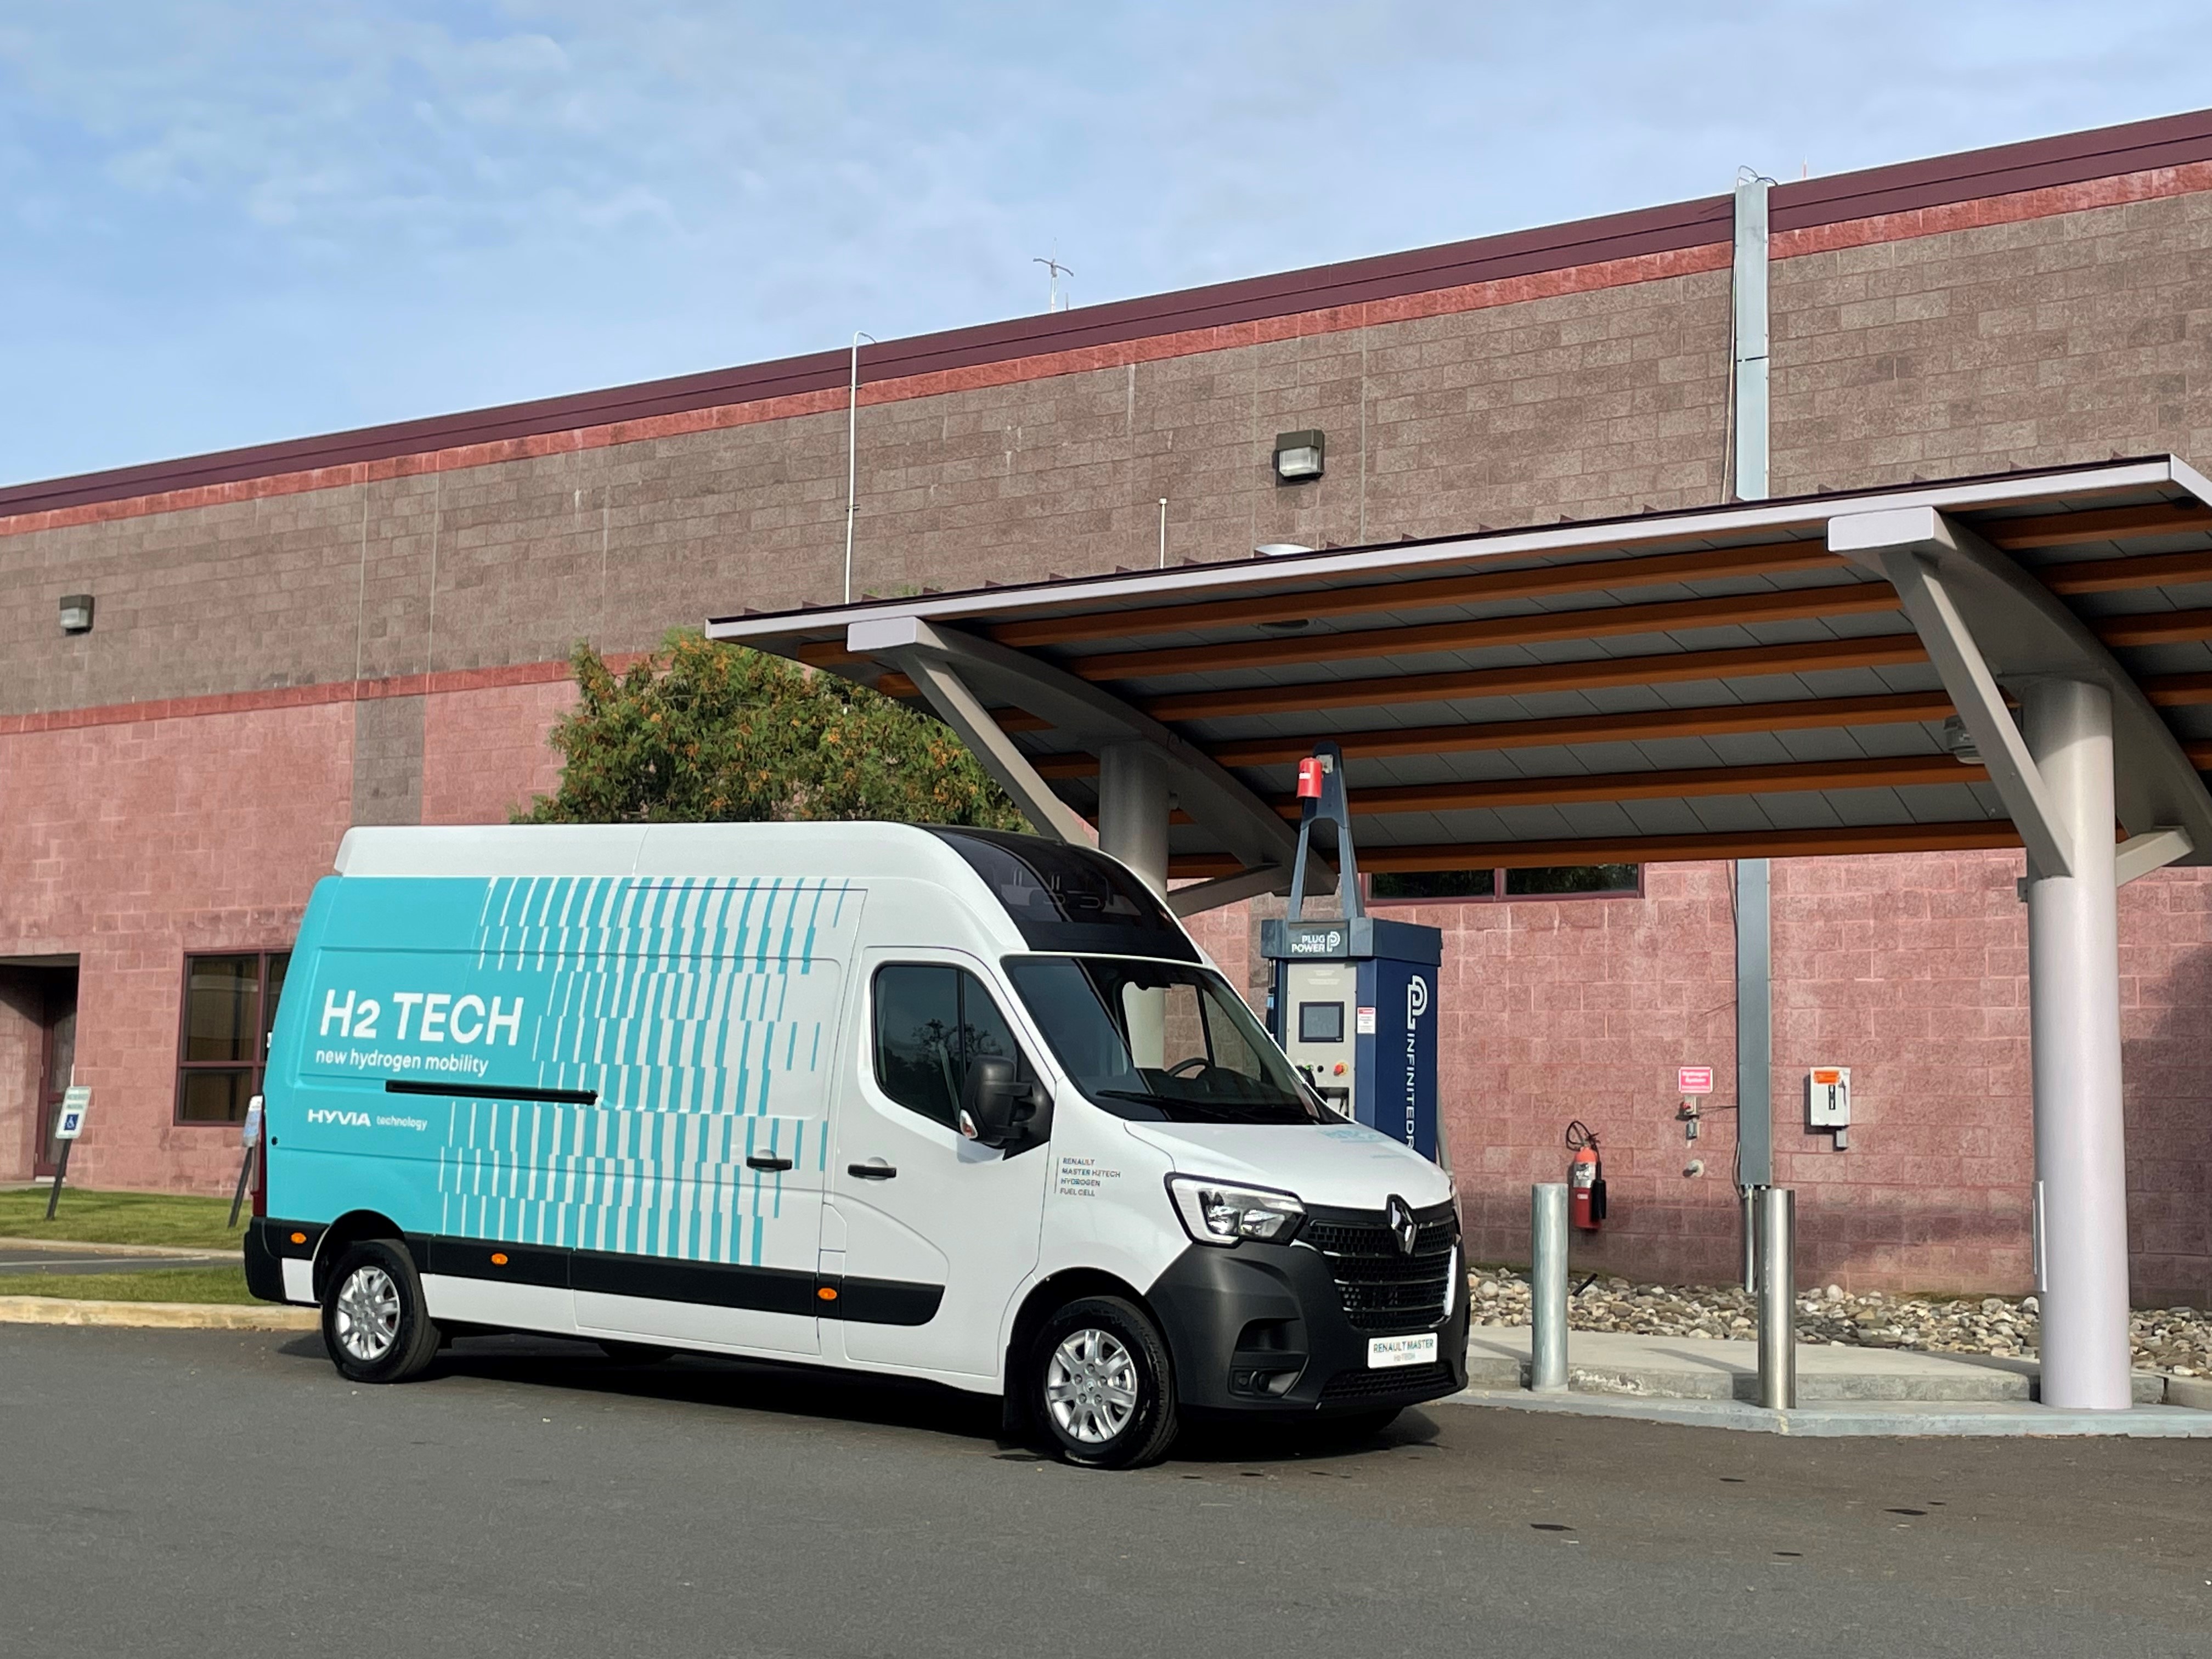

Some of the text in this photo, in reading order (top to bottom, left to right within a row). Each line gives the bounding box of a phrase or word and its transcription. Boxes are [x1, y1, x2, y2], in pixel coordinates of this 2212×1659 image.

[1301, 935, 1325, 943] PLUG
[1291, 944, 1325, 953] POWER
[320, 990, 524, 1046] H2 TECH
[316, 1048, 489, 1077] new hydrogen mobility
[308, 1109, 428, 1131] HYVIA technology
[1063, 1157, 1095, 1166] RENAULT
[1062, 1167, 1091, 1176] MASTER
[1060, 1178, 1101, 1187] HYDROGEN
[1059, 1188, 1095, 1197] FUEL CELL
[1373, 1338, 1434, 1353] RENAULT MASTER
